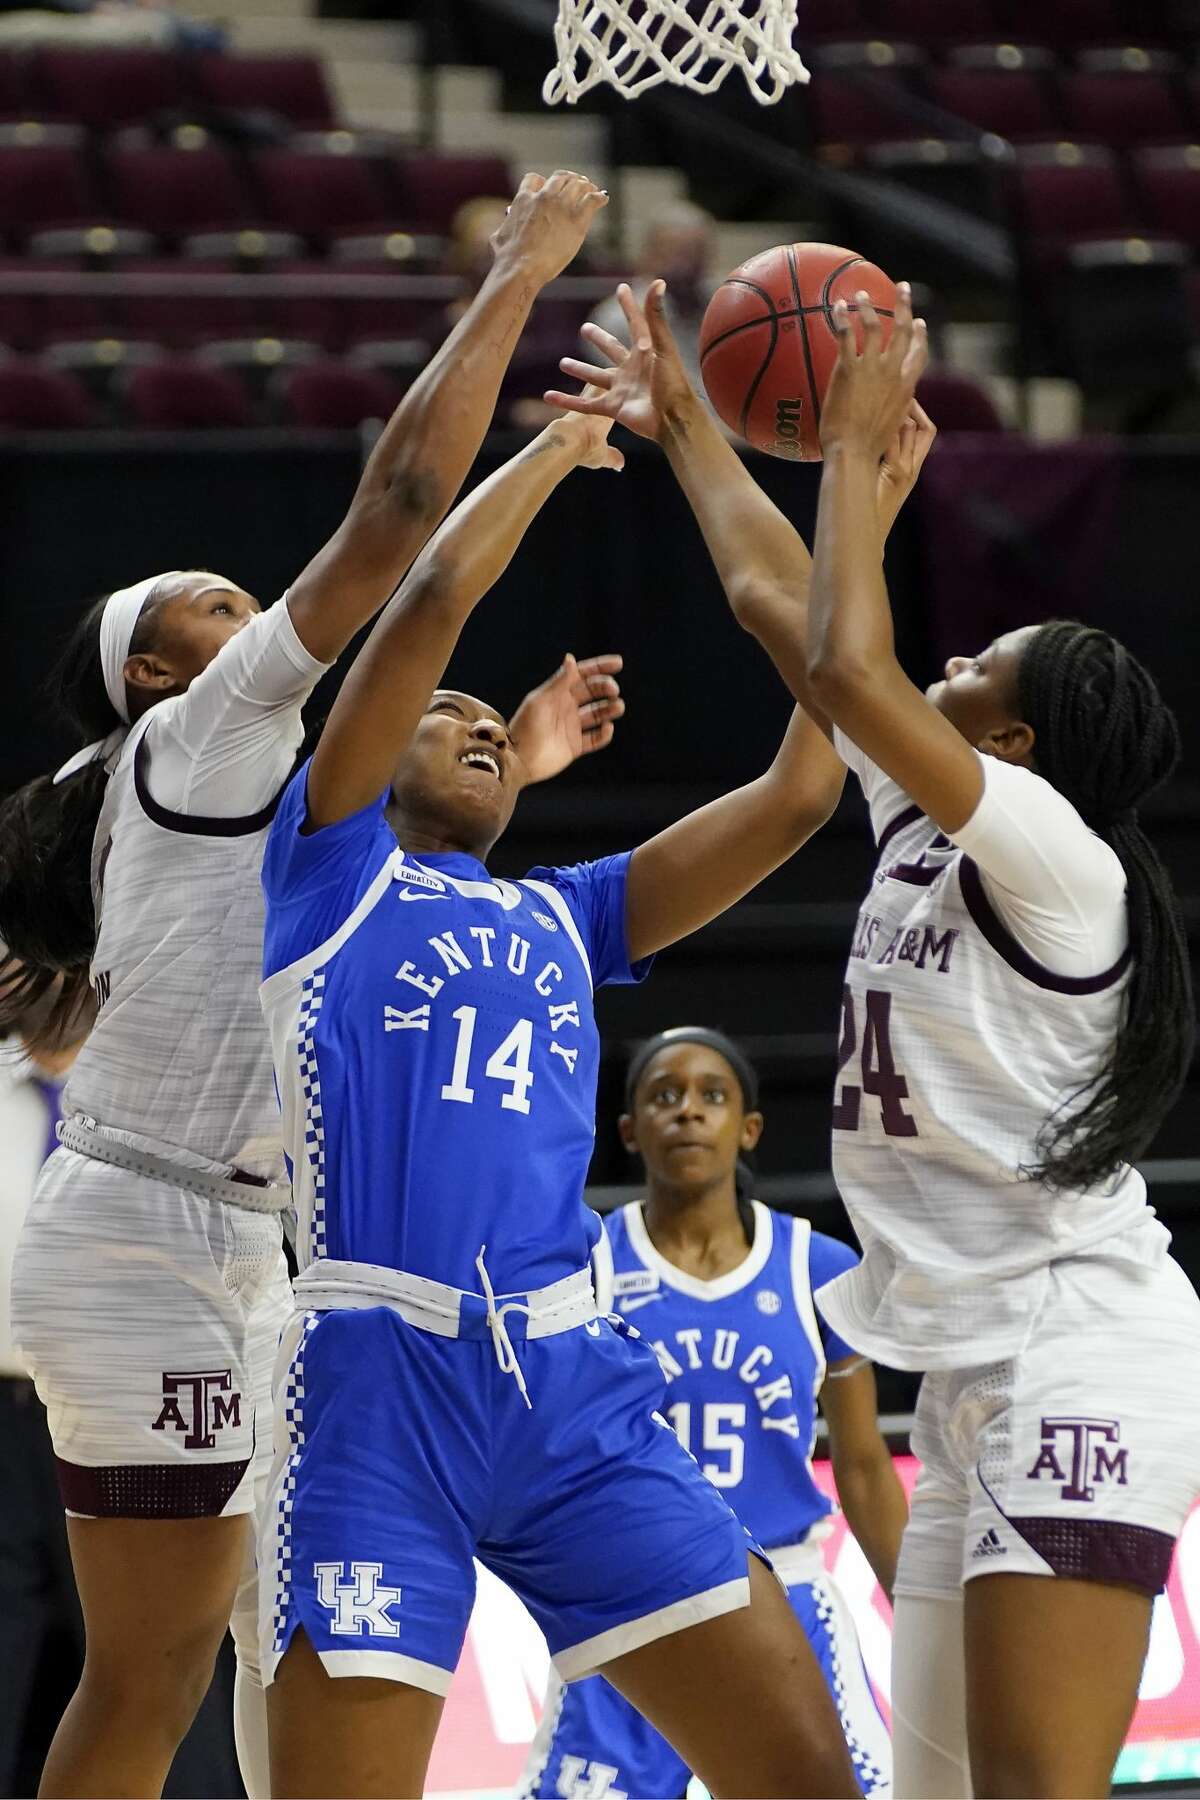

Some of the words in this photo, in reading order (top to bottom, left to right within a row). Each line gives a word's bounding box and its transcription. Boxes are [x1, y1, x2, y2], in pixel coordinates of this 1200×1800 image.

[401, 870, 439, 887] EQUALITY
[877, 925, 960, 973] A&M
[384, 926, 581, 1075] KENTUCKY
[441, 1005, 534, 1115] 14
[667, 1402, 746, 1488] 15
[313, 1561, 402, 1638] UK
